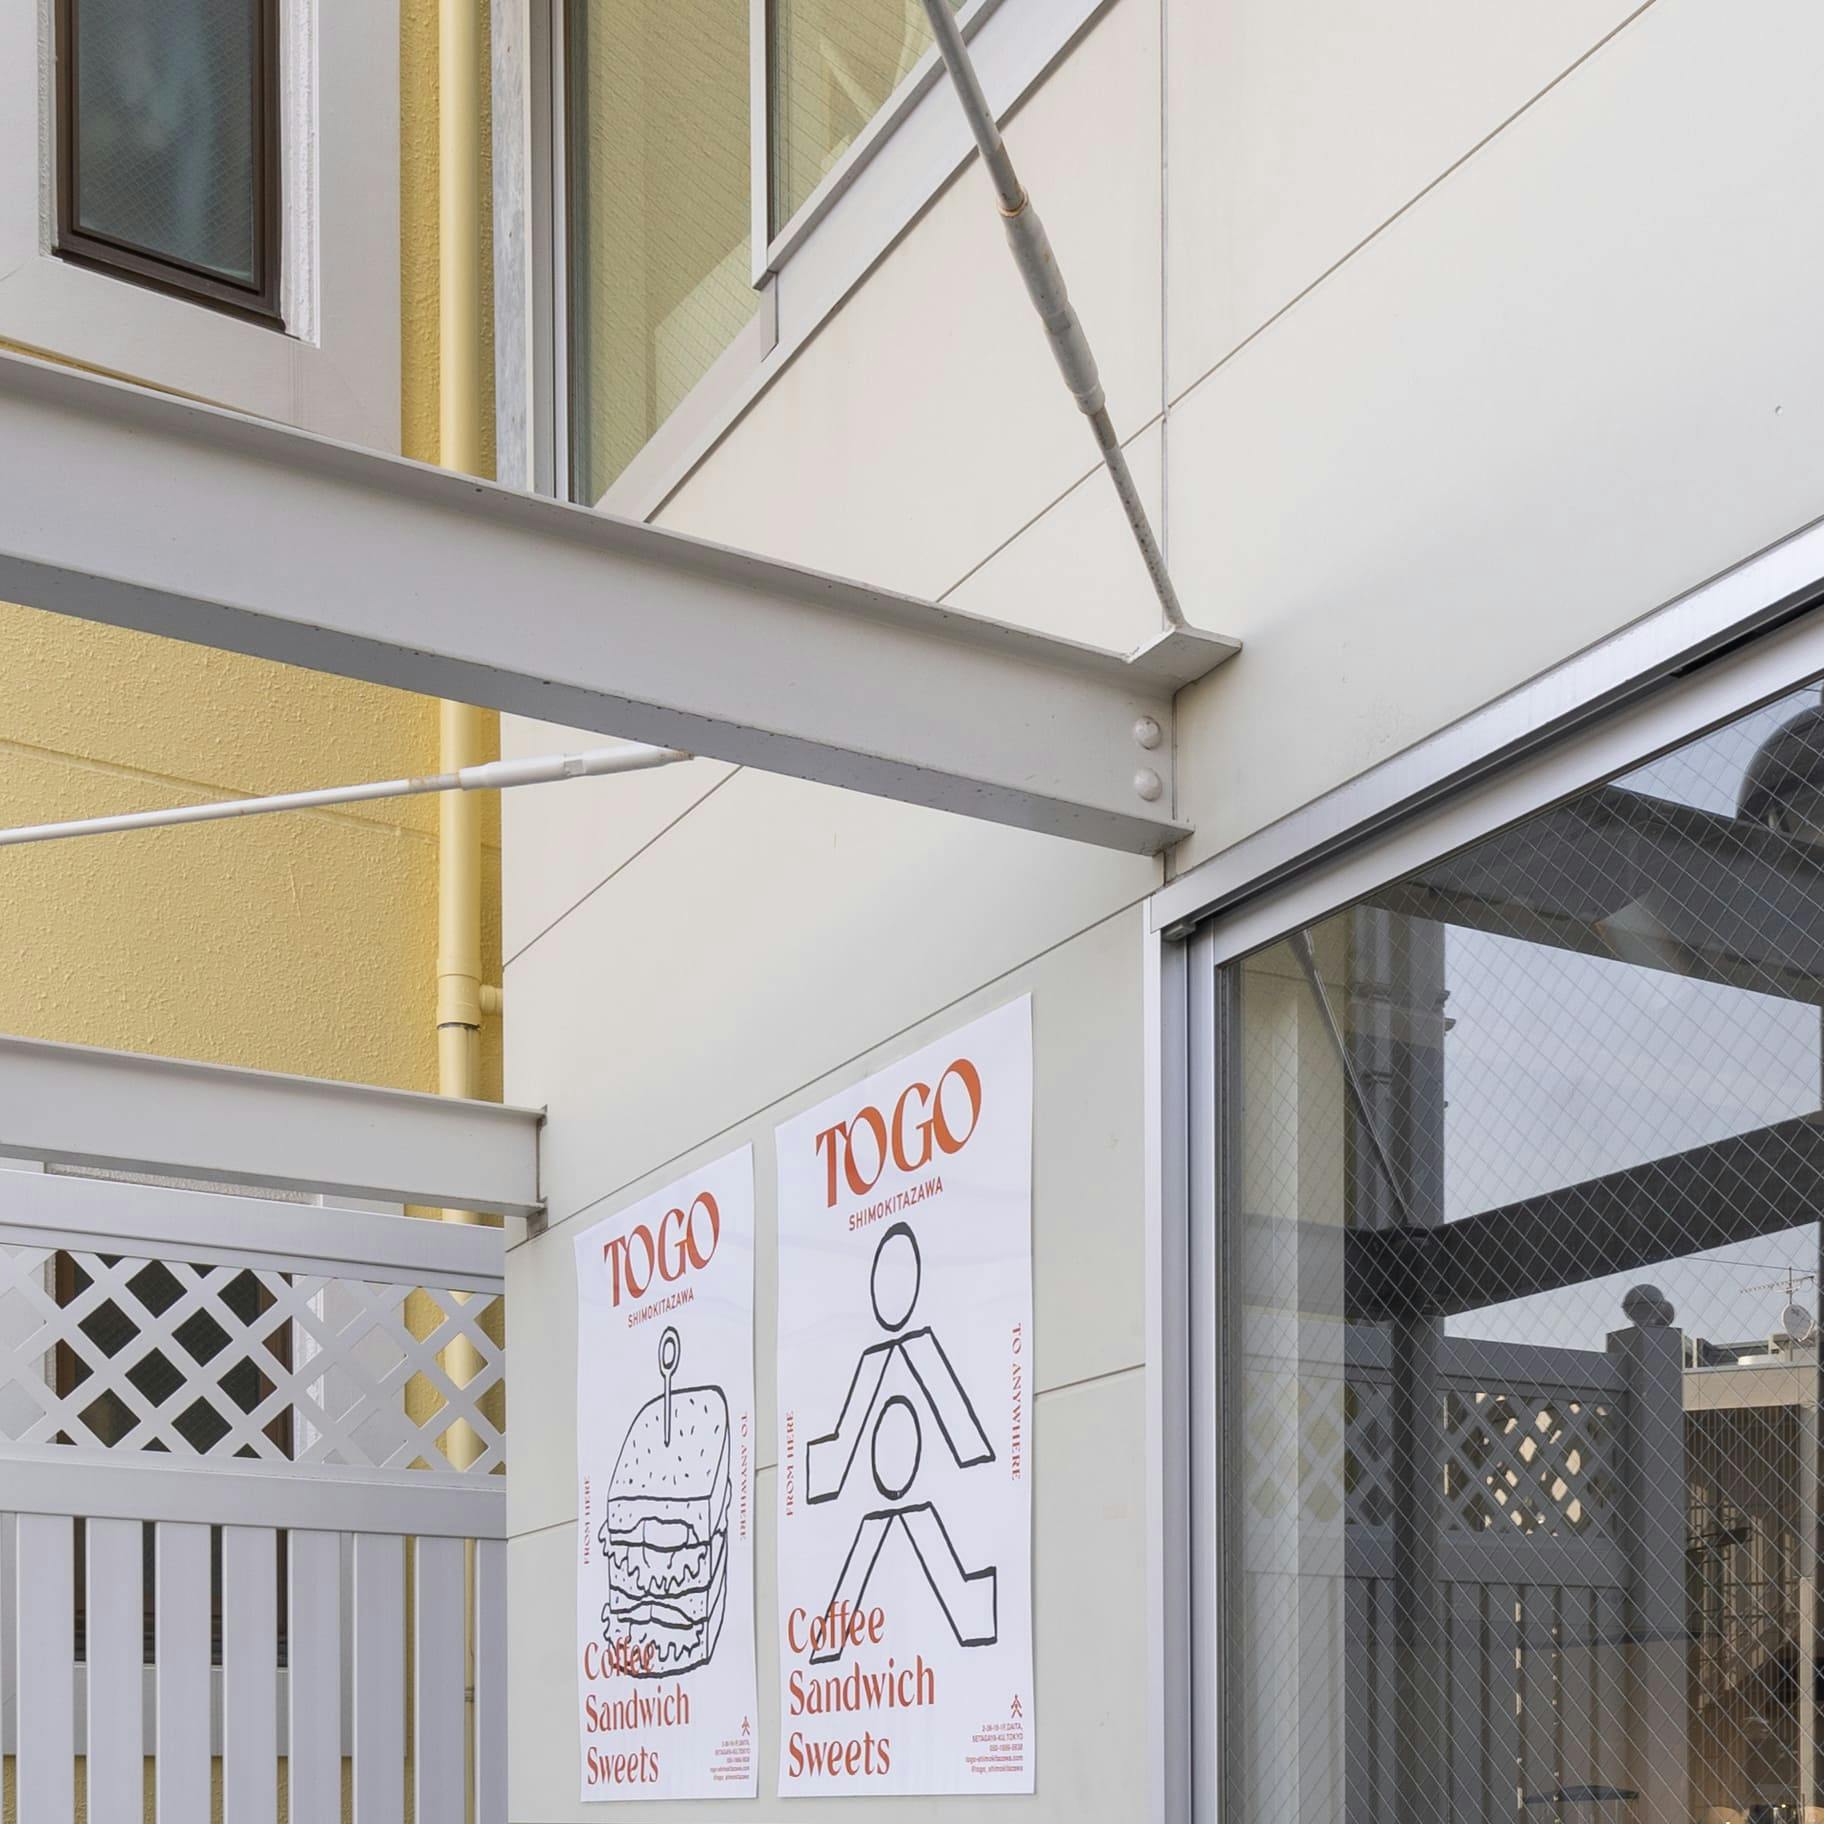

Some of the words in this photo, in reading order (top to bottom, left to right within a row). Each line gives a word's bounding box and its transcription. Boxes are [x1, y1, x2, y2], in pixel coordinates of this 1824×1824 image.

[816, 1058, 982, 1208] TOGO
[848, 1176, 943, 1232] SHIMOKITAZAWA
[603, 1191, 720, 1307] TOGO
[627, 1287, 695, 1329] SHIMOKITAZAWA
[1012, 1322, 1022, 1355] TO
[786, 1410, 794, 1458] HERE
[1012, 1363, 1021, 1481] ANYWHERE
[786, 1465, 794, 1516] FROM
[788, 1599, 885, 1654] Coffee
[584, 1635, 656, 1681] Coffee
[585, 1682, 690, 1733] Sandwich
[789, 1654, 935, 1716] Sandwich
[586, 1745, 659, 1785] Sweets
[789, 1730, 891, 1778] Sweets
